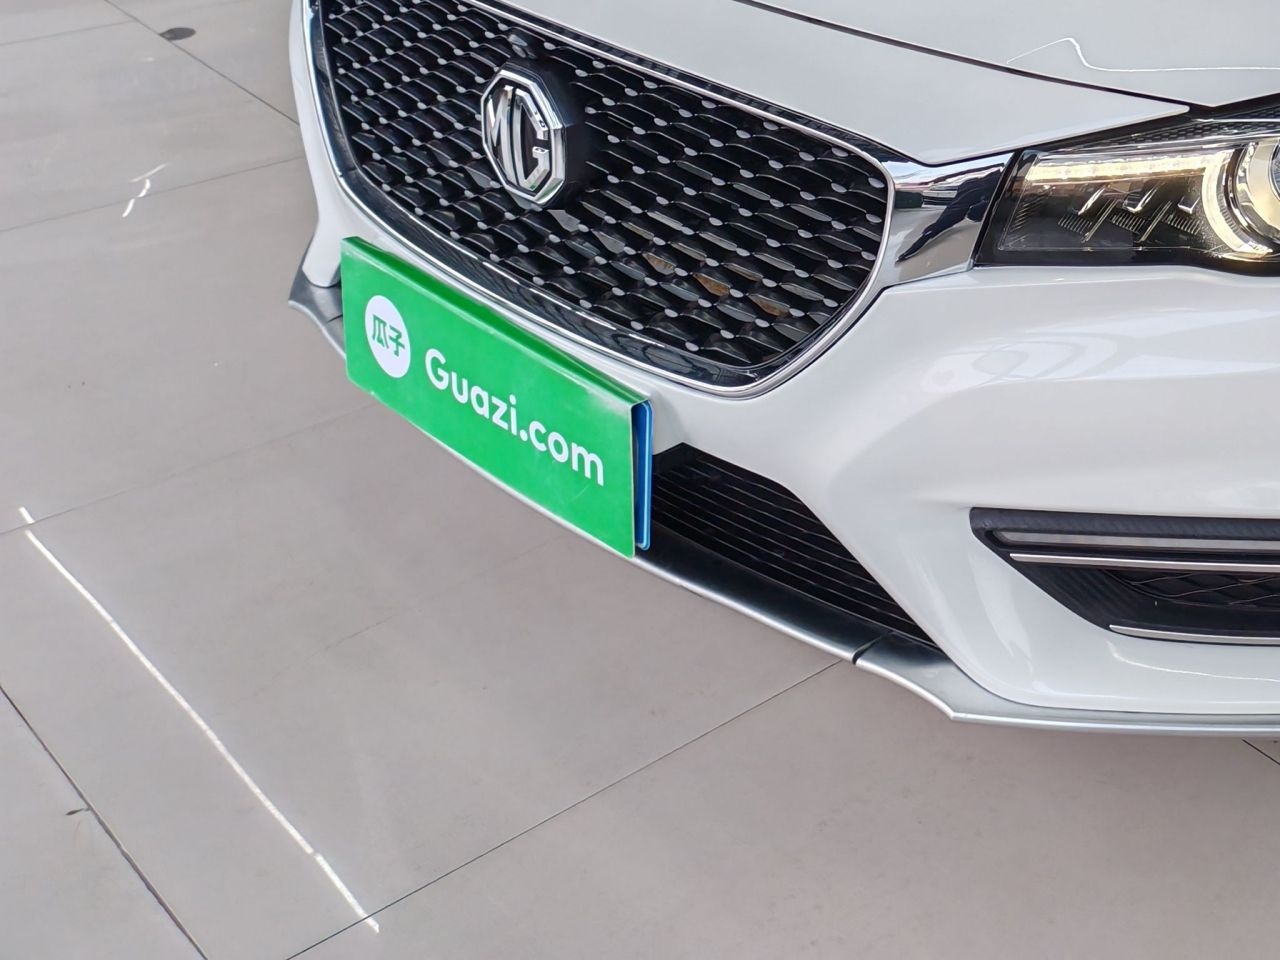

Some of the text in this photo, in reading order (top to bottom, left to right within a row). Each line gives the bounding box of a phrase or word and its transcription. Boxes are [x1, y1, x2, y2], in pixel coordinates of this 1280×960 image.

[486, 84, 550, 191] MG
[372, 314, 405, 357] 瓜子
[425, 348, 604, 487] Guazi.com
